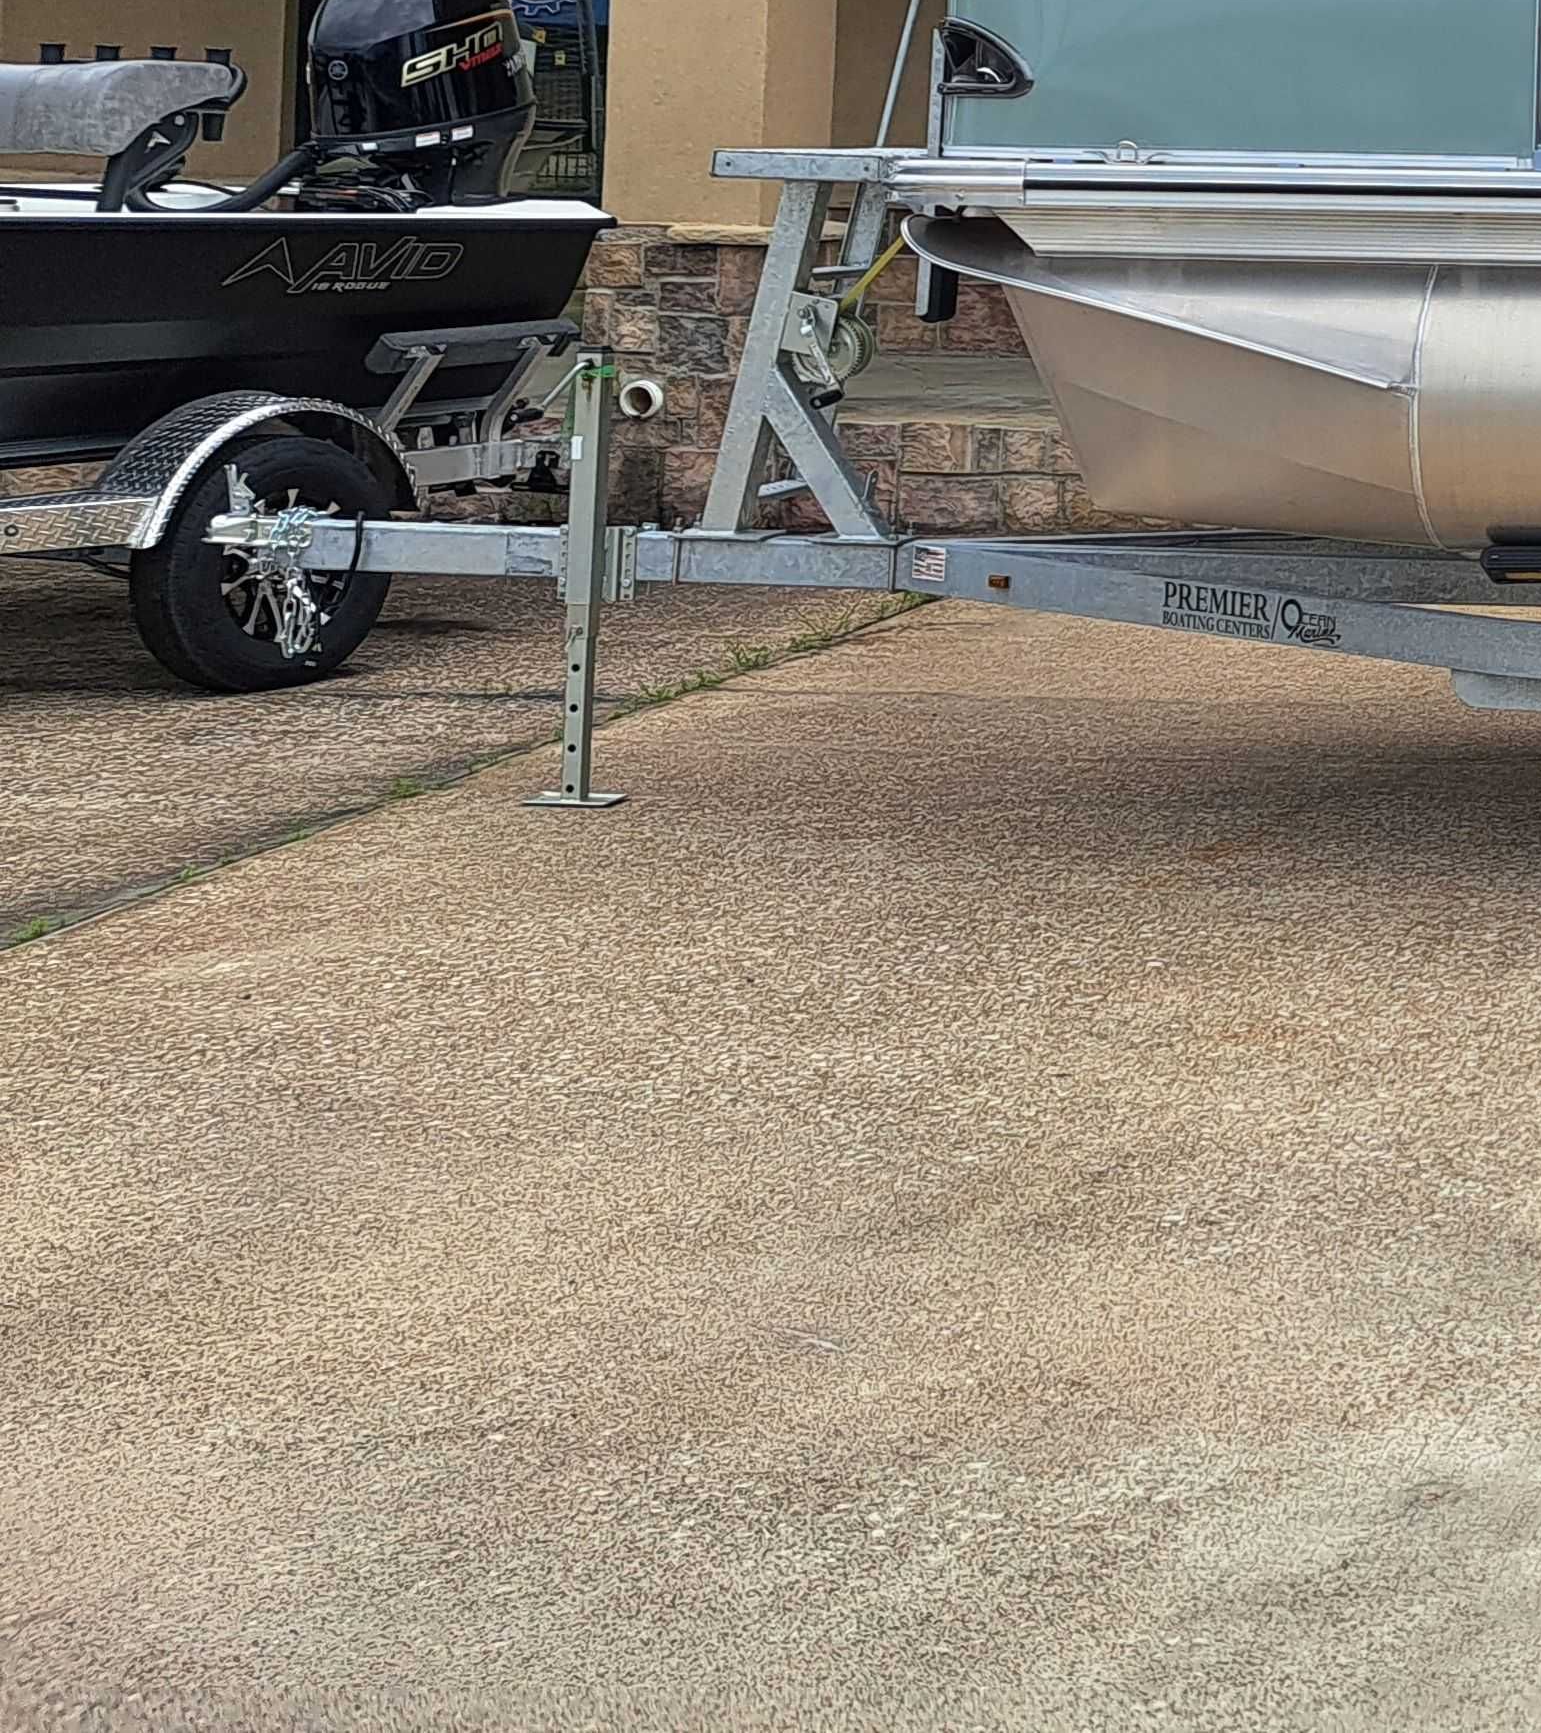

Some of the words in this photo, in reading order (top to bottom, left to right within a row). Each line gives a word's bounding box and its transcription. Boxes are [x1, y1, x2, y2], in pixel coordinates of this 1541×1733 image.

[287, 235, 464, 293] AVID
[1162, 580, 1270, 623] PREMIER
[1162, 610, 1215, 632] BOATING
[1216, 618, 1271, 640] CENTERS
